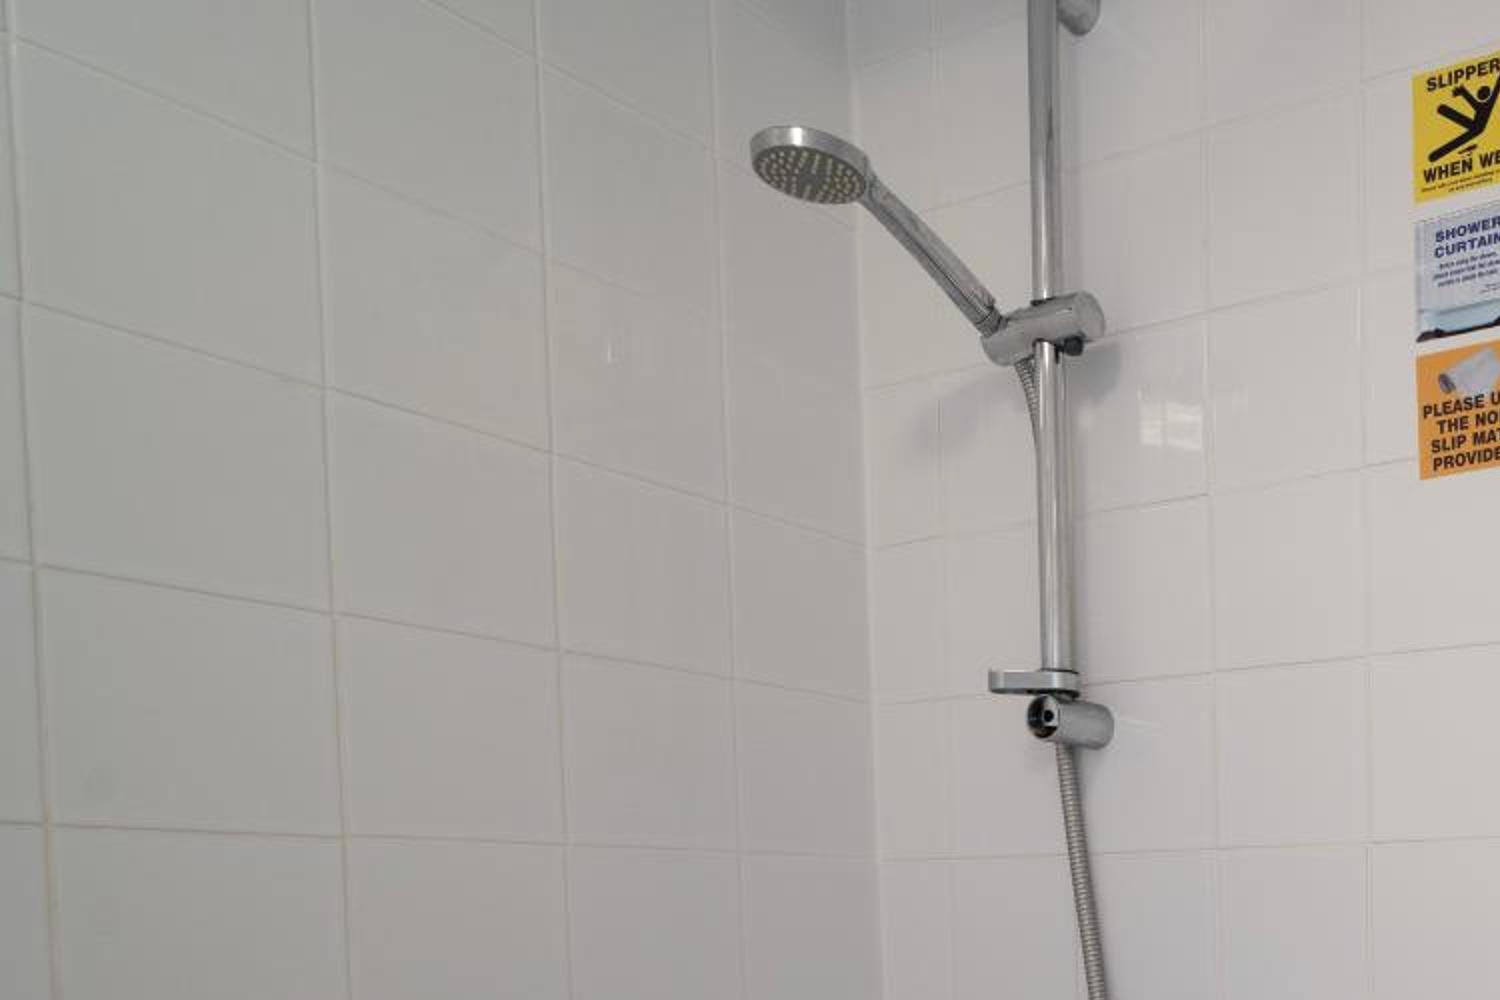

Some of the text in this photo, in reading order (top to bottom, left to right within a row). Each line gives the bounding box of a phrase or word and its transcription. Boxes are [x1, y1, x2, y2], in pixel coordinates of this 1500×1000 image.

[1423, 157, 1473, 184] WHEN
[1423, 393, 1485, 419] PLEASE
[1437, 415, 1469, 434] THE
[1431, 434, 1467, 454] SLIP
